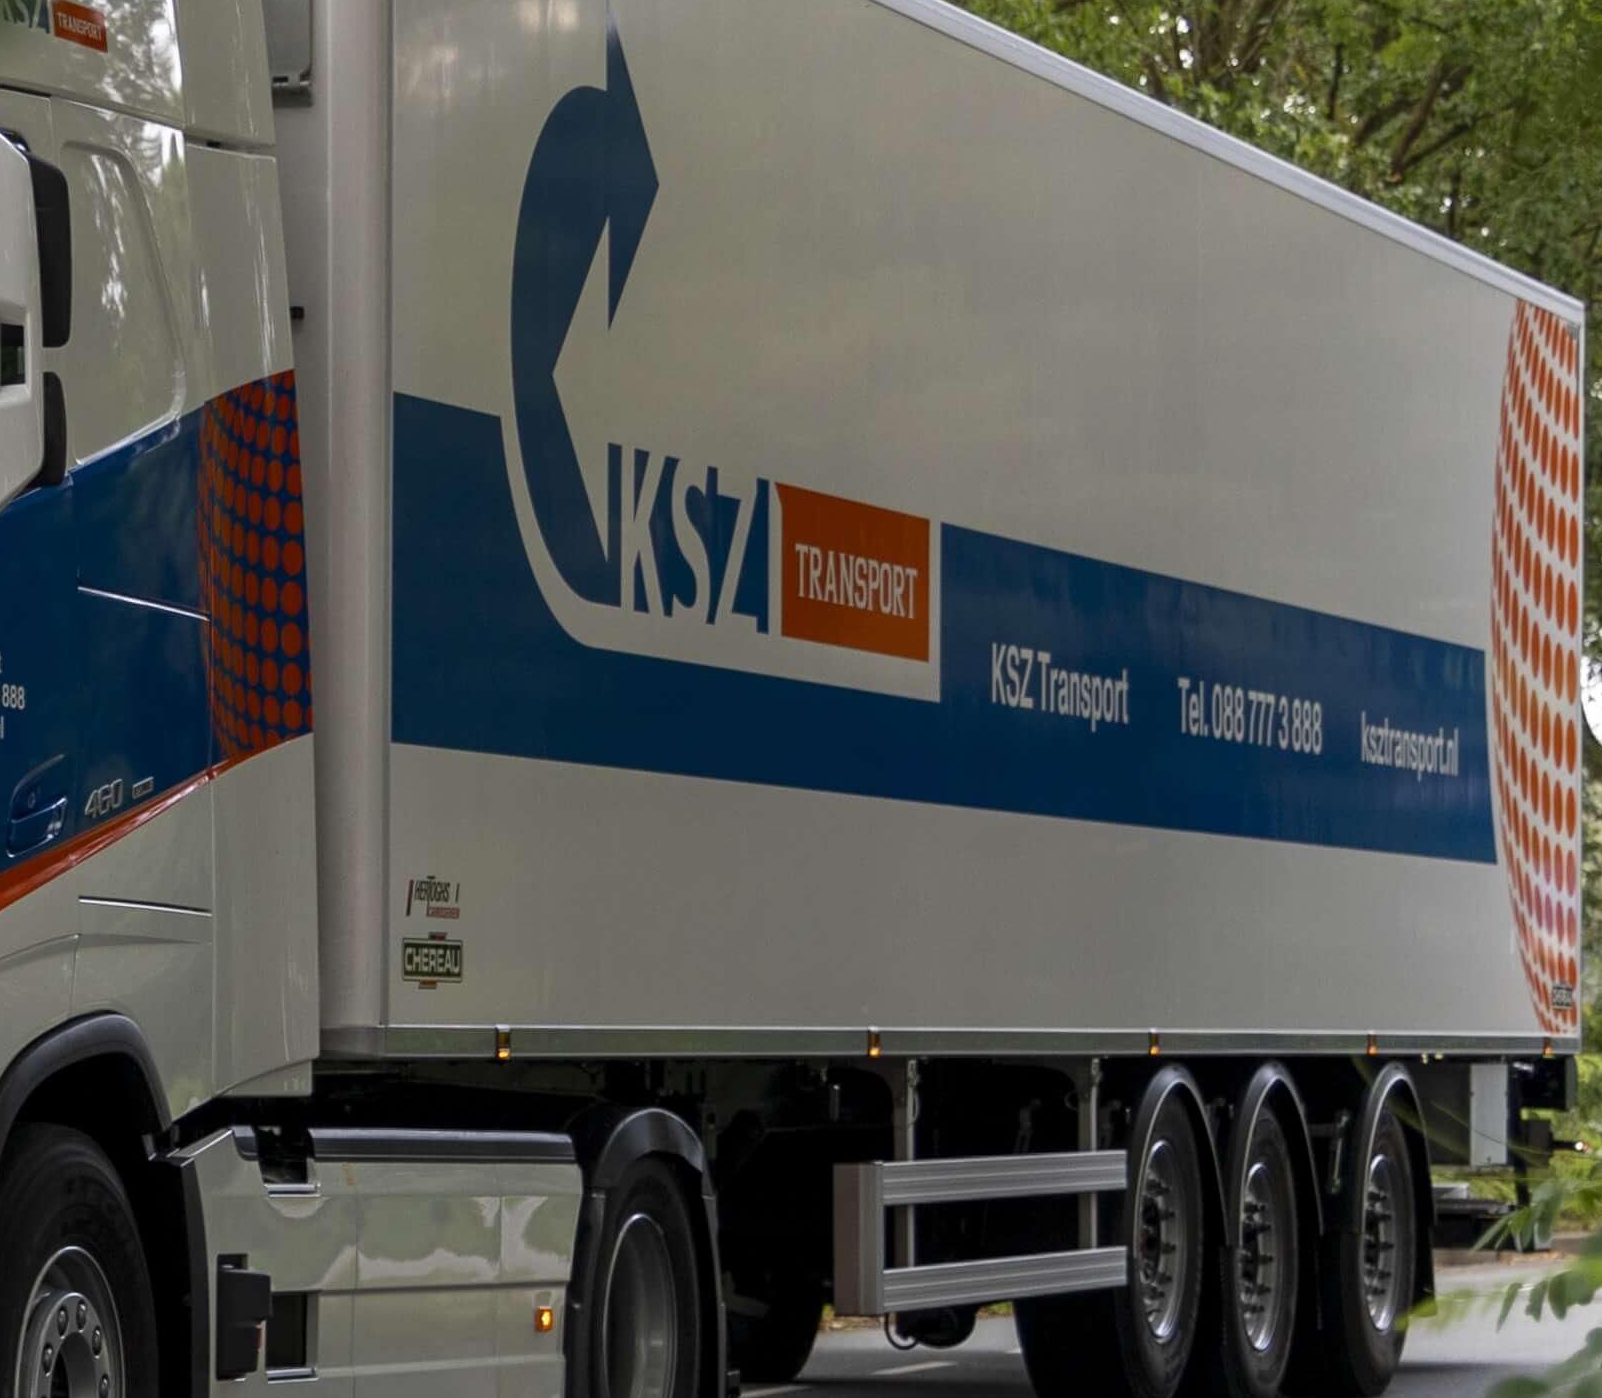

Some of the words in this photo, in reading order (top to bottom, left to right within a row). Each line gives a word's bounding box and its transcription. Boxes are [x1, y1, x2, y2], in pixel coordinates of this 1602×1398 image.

[57, 10, 101, 43] TRANSPORT
[612, 444, 770, 633] KSZ
[794, 542, 919, 620] TRANSPORT
[1, 683, 25, 710] 888
[991, 641, 1034, 709] KSZ
[1037, 650, 1130, 733] Transport
[1177, 676, 1208, 738] Tel.
[1211, 682, 1245, 743] 088
[1248, 690, 1275, 746] 777
[1278, 694, 1288, 749] 3
[1291, 697, 1322, 754] 888
[1360, 710, 1459, 783] ksztransport.nl
[404, 947, 460, 972] CHEREAU
